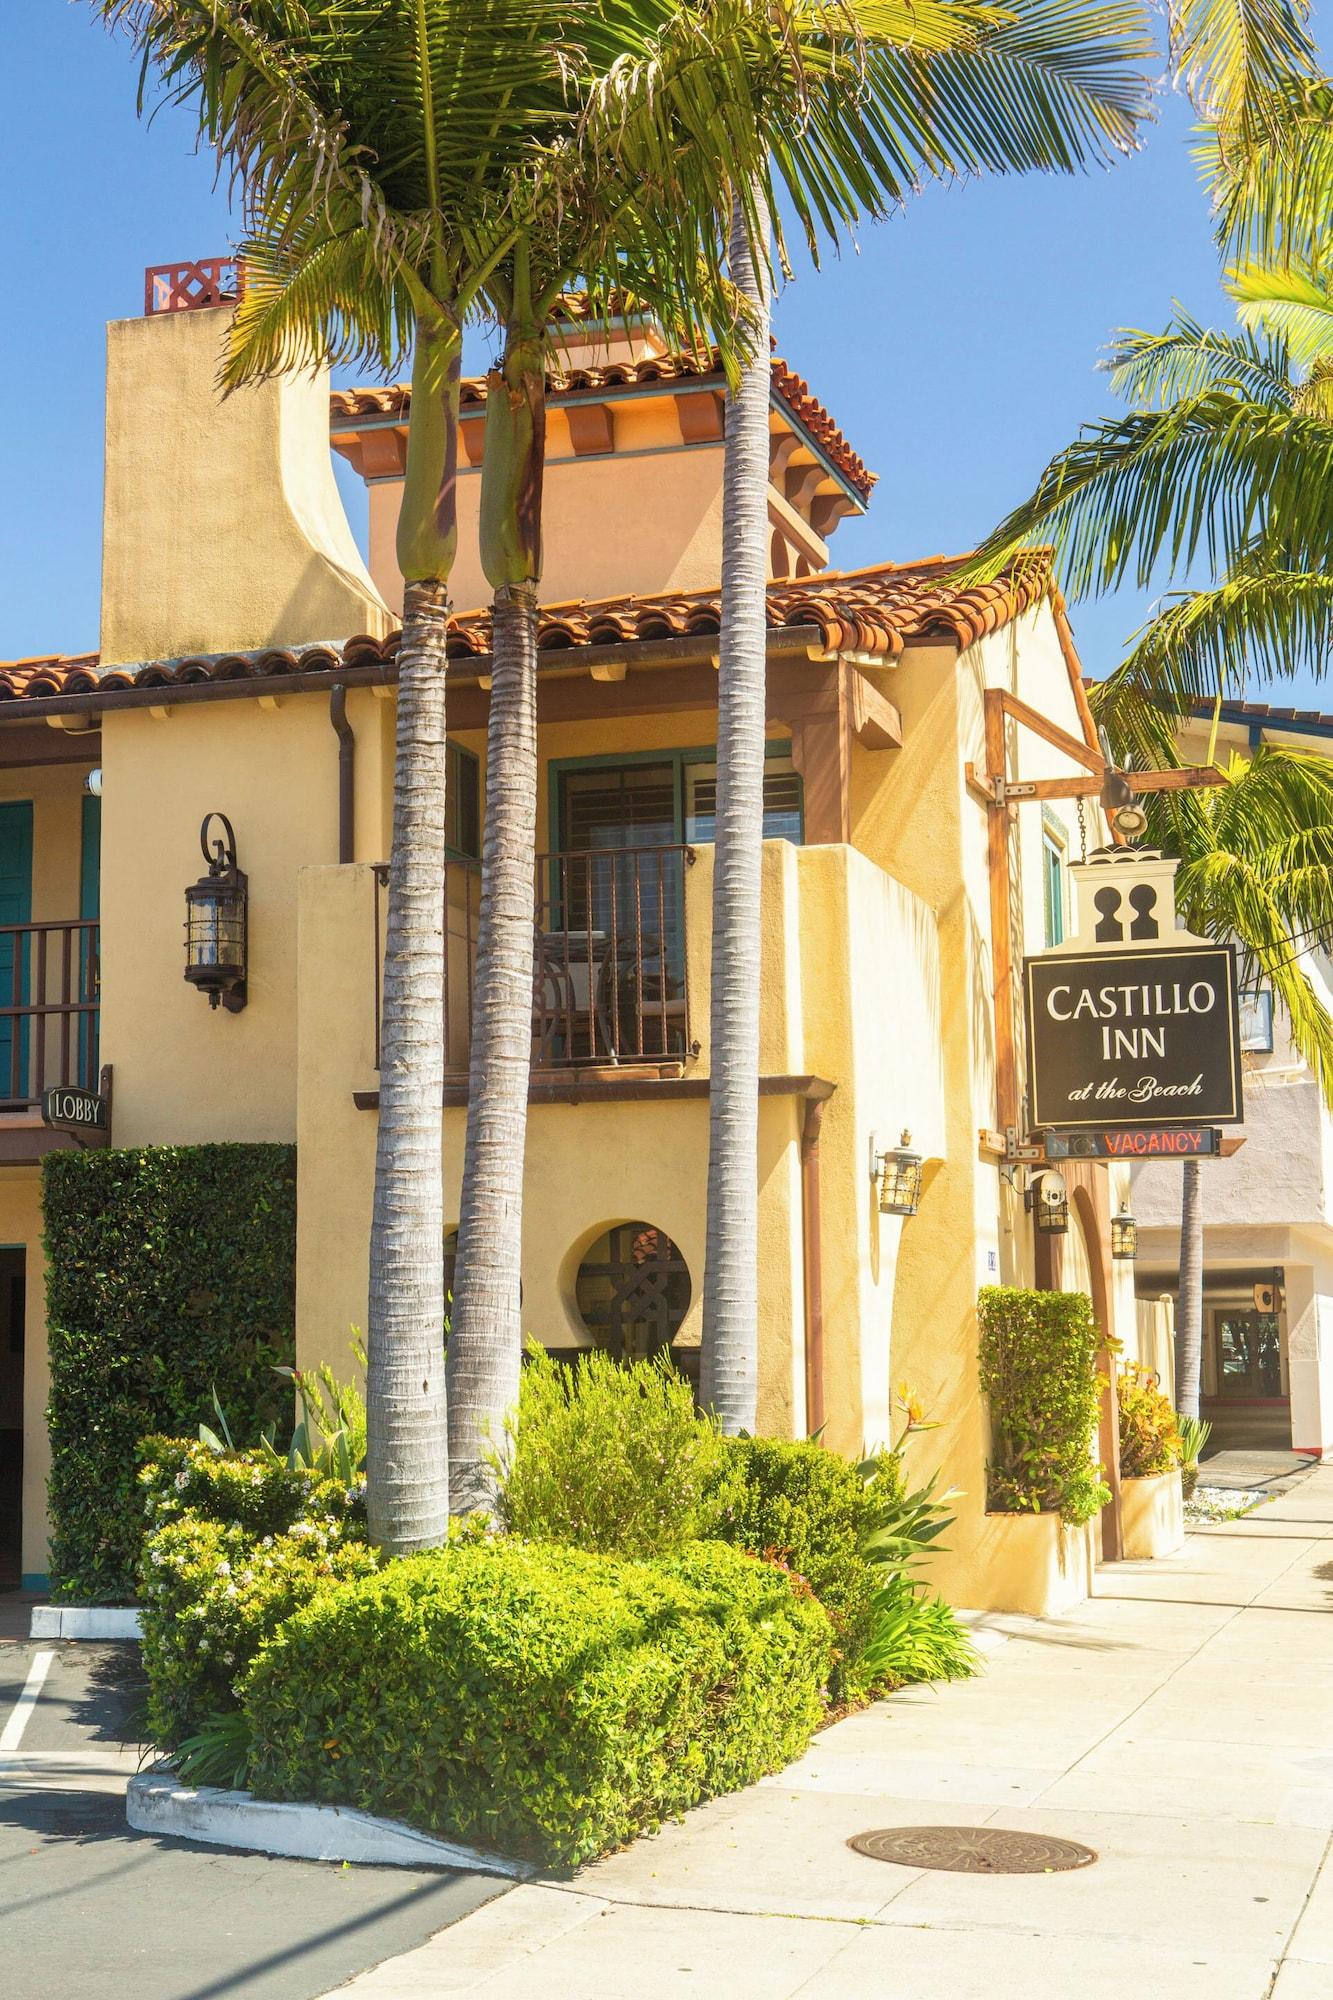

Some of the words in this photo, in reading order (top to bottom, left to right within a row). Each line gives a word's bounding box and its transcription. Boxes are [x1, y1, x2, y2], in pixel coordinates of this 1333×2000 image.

[1046, 981, 1216, 1021] CASTILLO
[1101, 1026, 1165, 1061] INN
[1067, 1082, 1094, 1101] at
[1095, 1077, 1127, 1100] the
[1127, 1073, 1204, 1103] Beach
[55, 1093, 100, 1123] LOBBY
[1104, 1131, 1201, 1154] VACANCY
